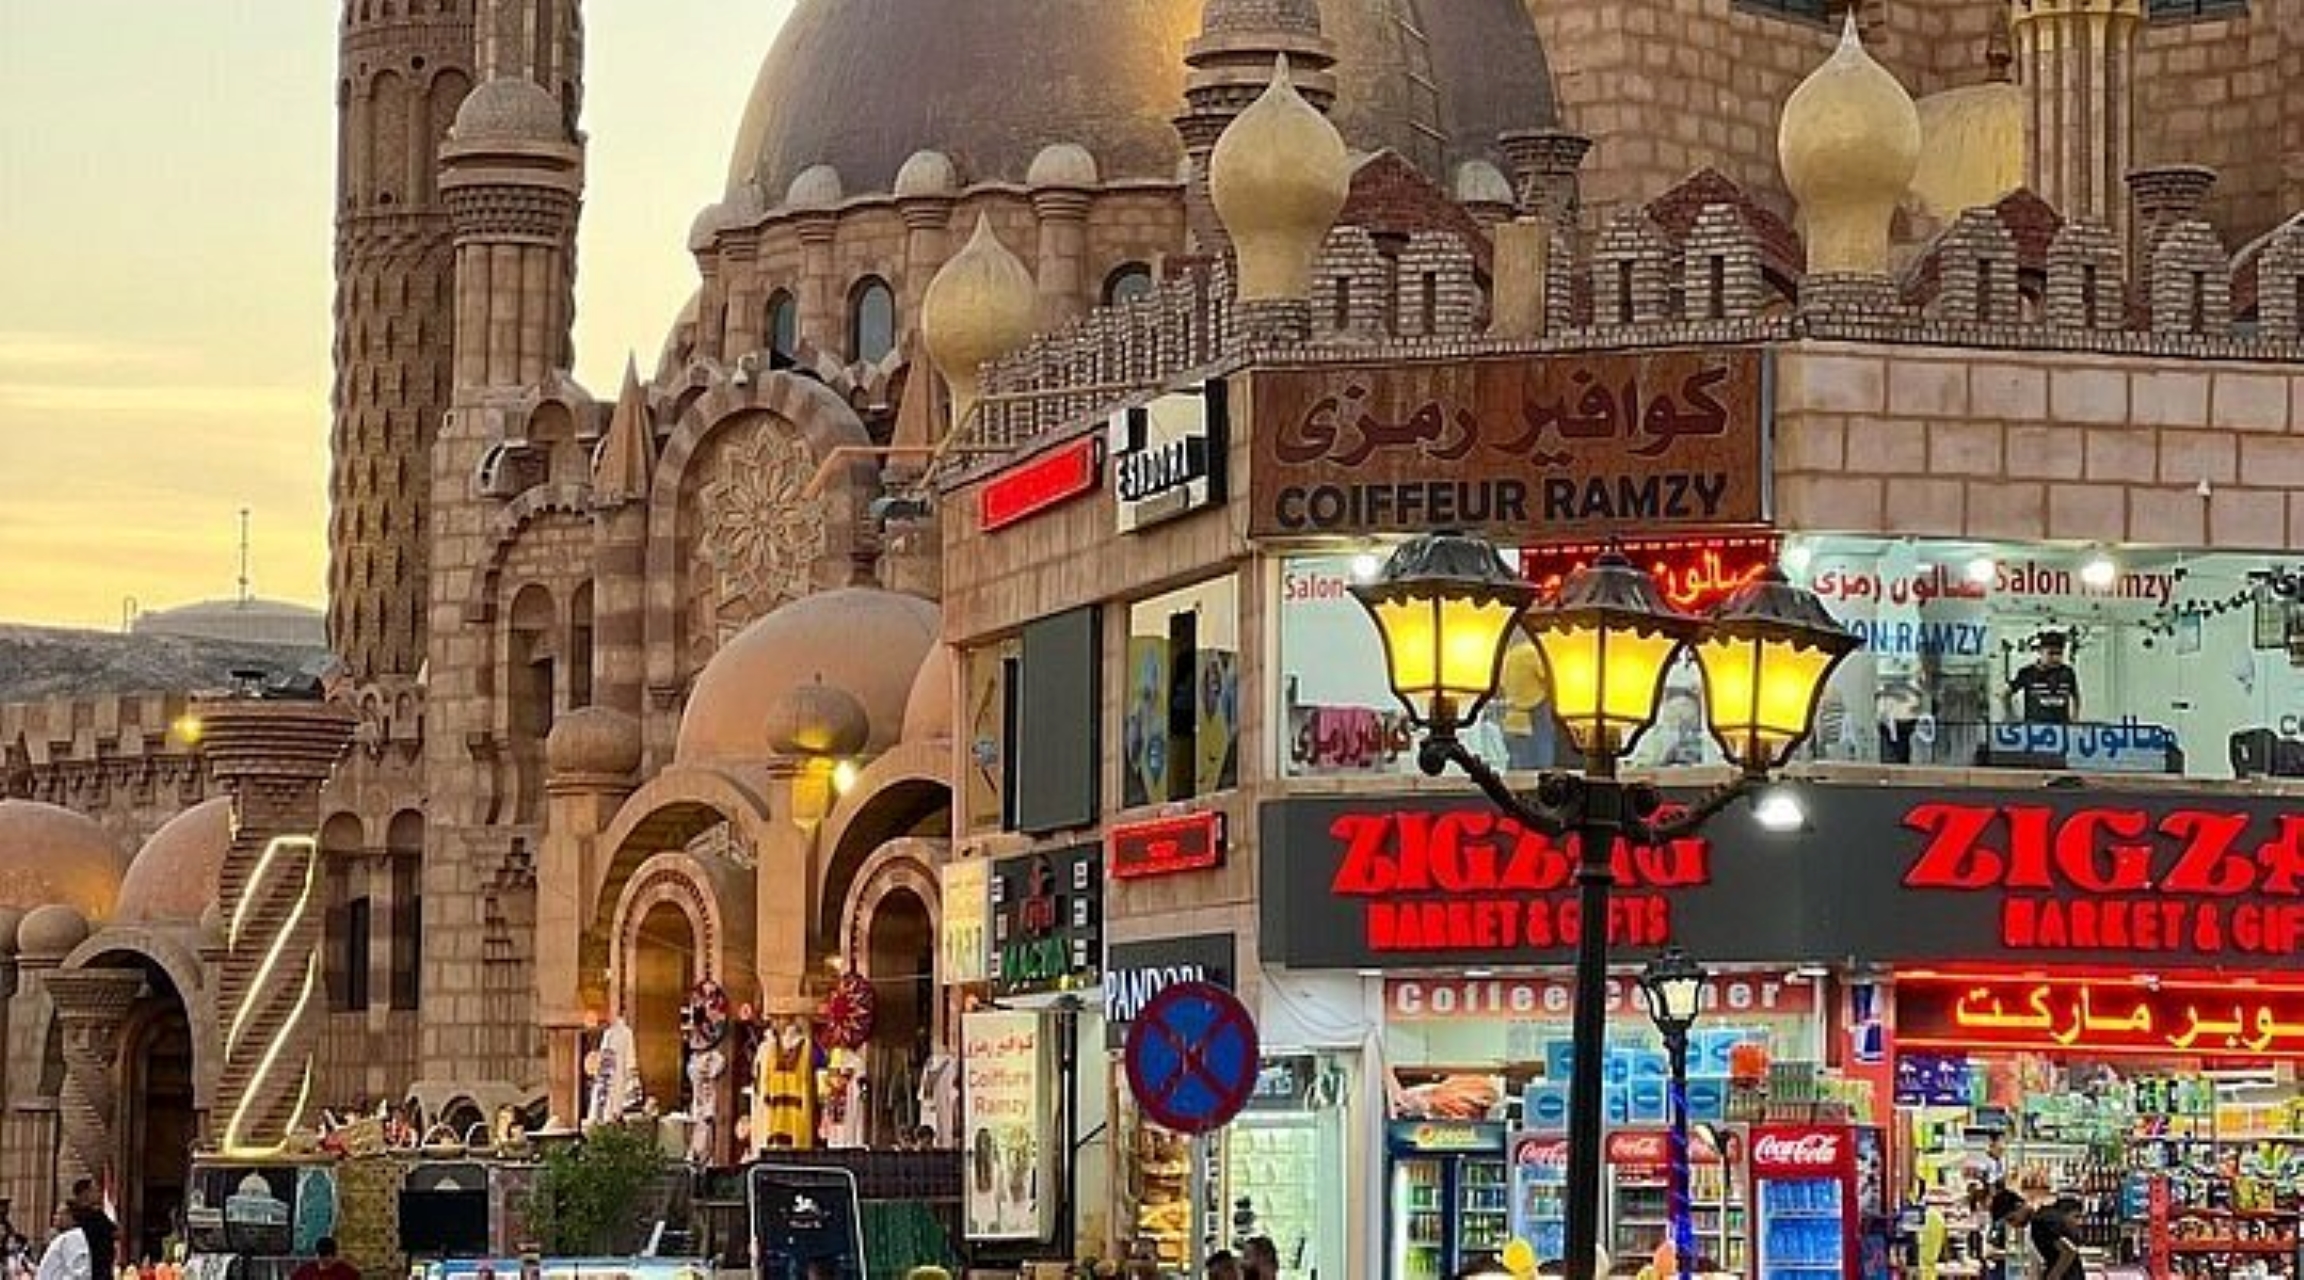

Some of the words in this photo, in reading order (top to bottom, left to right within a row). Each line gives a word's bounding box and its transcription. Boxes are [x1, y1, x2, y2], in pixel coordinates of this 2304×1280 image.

[1493, 364, 1730, 466] كوافير
[1275, 478, 1527, 528] COIFFEUR
[1544, 472, 1728, 523] RAMZY
[1285, 572, 1344, 600] Salon
[1994, 559, 2071, 596] Salon
[2081, 566, 2173, 608] mzy
[1896, 621, 1988, 656] RAMZY
[1368, 898, 1519, 950] MARKET
[1527, 899, 1550, 947] &
[1558, 896, 1669, 947] GFTS
[2004, 898, 2184, 949] MARKET
[2195, 904, 2222, 952] &
[1396, 981, 1569, 1015] Coffee
[1603, 979, 1780, 1011] Coner
[1956, 985, 2151, 1047] ماركت
[2165, 1005, 2304, 1052] وبر
